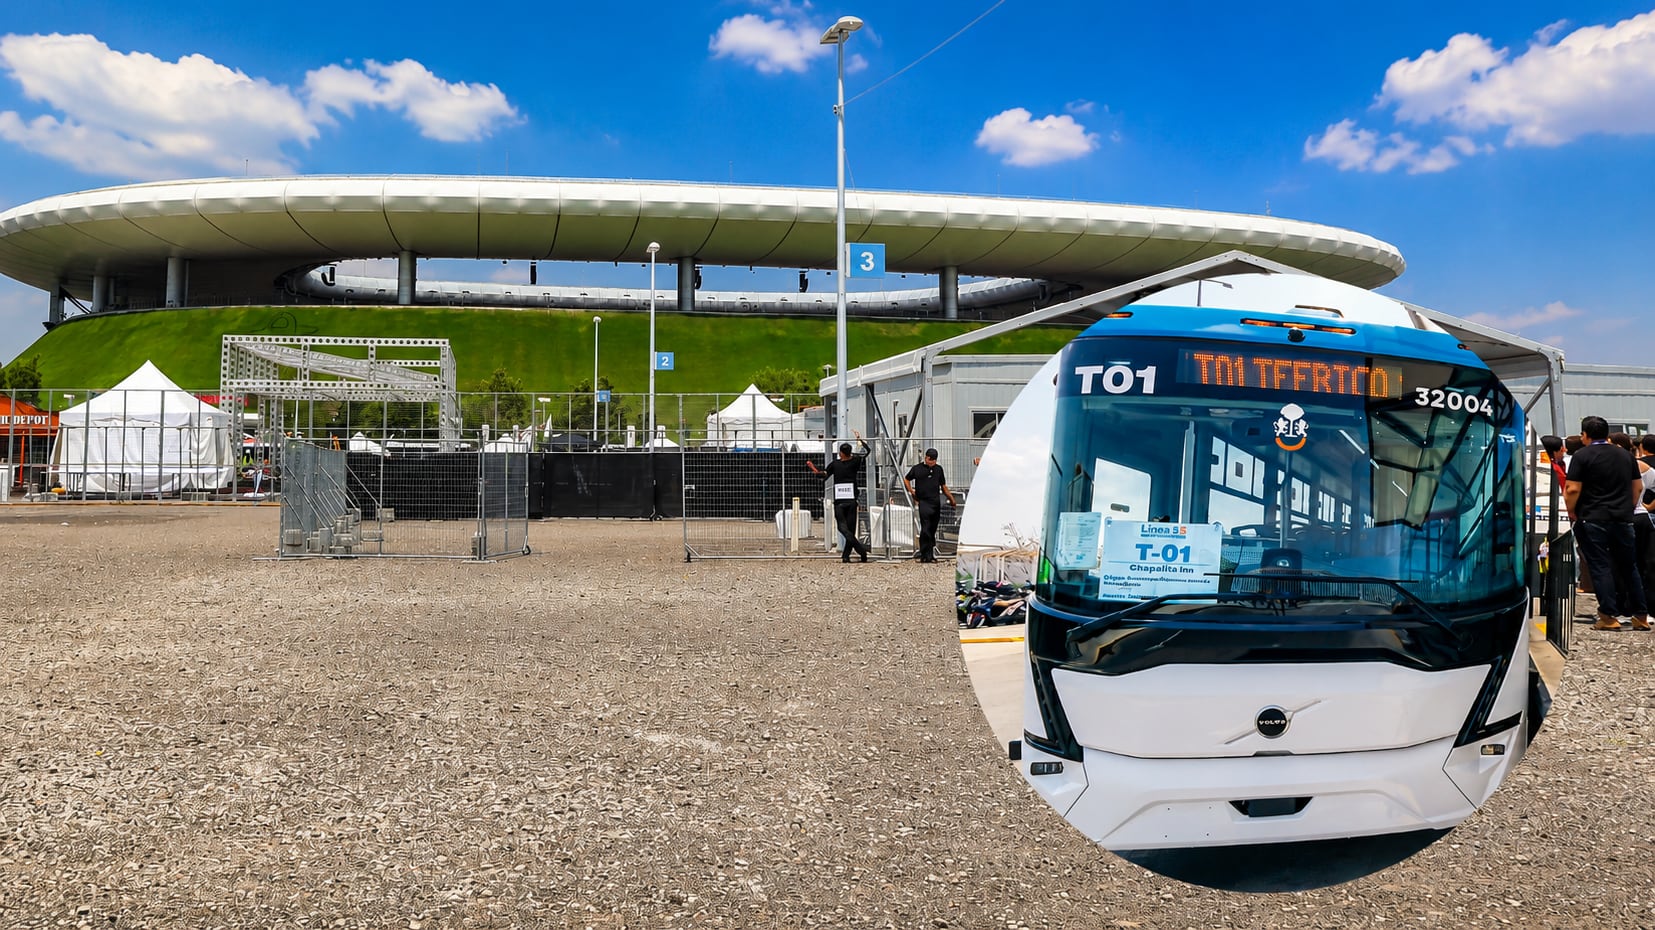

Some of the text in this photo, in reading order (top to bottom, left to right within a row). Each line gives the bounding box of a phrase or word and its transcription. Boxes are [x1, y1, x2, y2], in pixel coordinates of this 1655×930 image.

[860, 251, 875, 272] 3
[661, 356, 669, 366] 2
[1415, 387, 1493, 417] 32004
[13, 415, 48, 425] DEPOT
[1135, 543, 1191, 563] T-01
[1129, 564, 1178, 574] Chapalita
